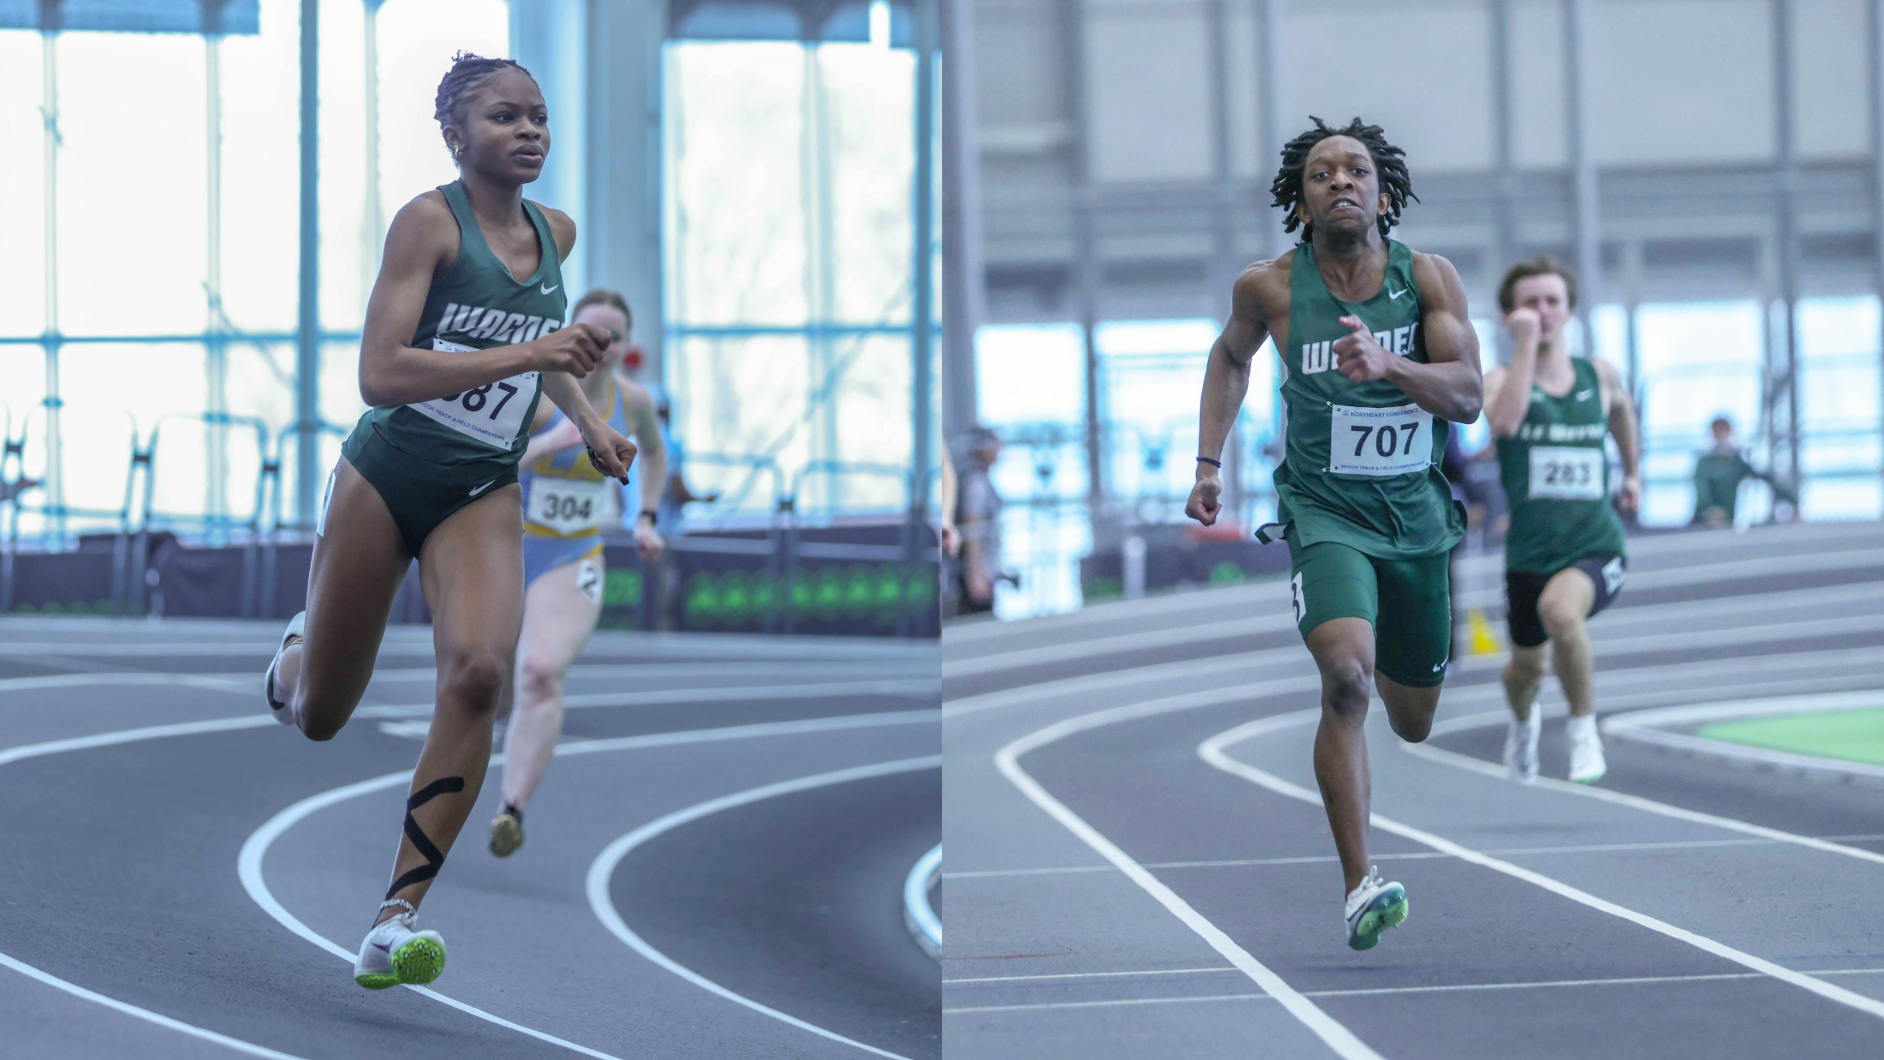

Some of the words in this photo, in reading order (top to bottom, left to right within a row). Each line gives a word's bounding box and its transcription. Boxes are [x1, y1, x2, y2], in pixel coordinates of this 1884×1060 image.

[437, 302, 564, 345] WAGNE
[419, 401, 435, 411] DOOR
[435, 409, 452, 419] TRACK
[456, 418, 471, 428] FIELD
[441, 382, 518, 420] 87
[1386, 407, 1419, 417] CONFERENCE
[1351, 421, 1419, 457] 707
[1544, 460, 1591, 486] 283
[542, 493, 592, 522] 304
